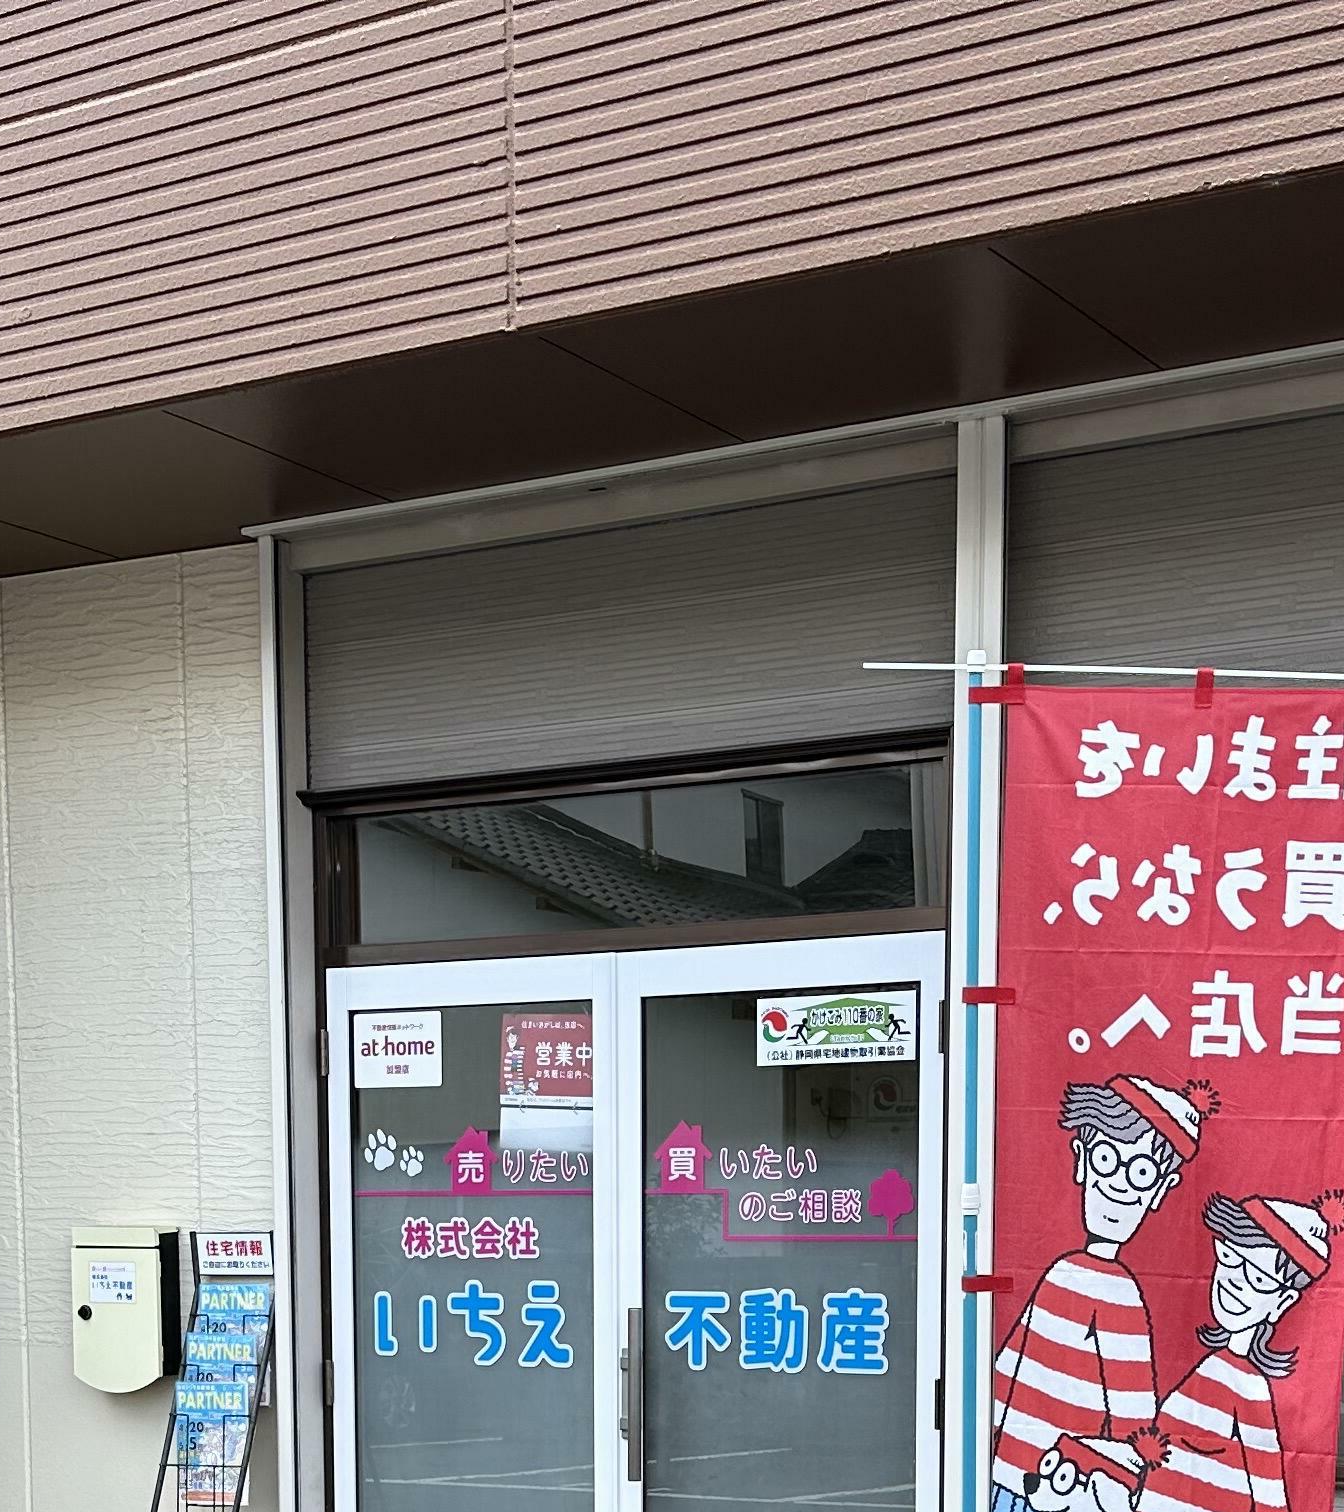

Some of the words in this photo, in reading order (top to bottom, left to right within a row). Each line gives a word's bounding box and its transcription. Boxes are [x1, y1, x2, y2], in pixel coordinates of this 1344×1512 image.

[360, 1038, 379, 1057] at
[381, 1035, 435, 1056] home
[535, 1041, 592, 1067] 営業中
[456, 1148, 590, 1184] 売りたい
[667, 1143, 818, 1182] 買いたい
[738, 1187, 863, 1224] のご相談
[206, 1239, 264, 1257] 住宅情報
[401, 1216, 540, 1260] 株式会社
[200, 1291, 265, 1311] PARTNER
[211, 1321, 227, 1333] 20
[373, 1279, 574, 1368] いちえ
[663, 1286, 890, 1375] 不動産
[189, 1342, 251, 1362] PARTNER
[177, 1390, 243, 1410] PARTNER
[189, 1421, 204, 1433] 20
